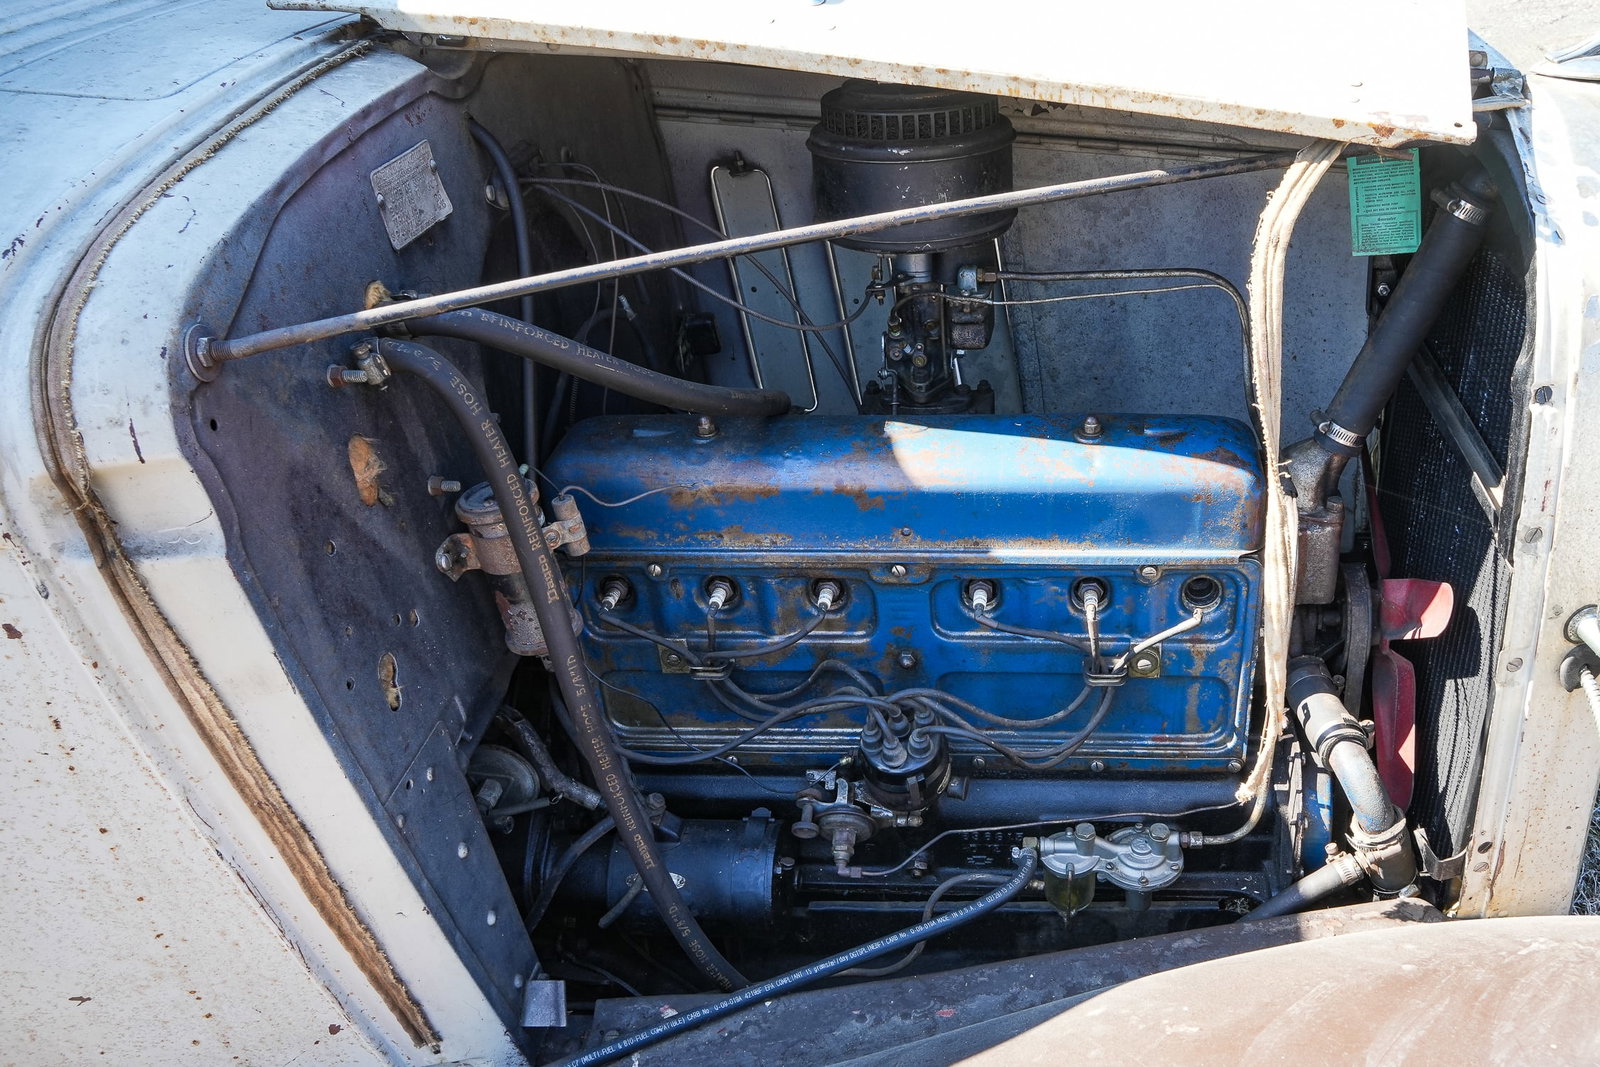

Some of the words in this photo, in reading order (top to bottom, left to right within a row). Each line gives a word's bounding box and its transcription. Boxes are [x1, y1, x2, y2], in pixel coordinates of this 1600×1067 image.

[576, 344, 620, 366] HEATER
[481, 418, 510, 468] HEATER
[507, 475, 541, 551] REINFORCED
[590, 735, 611, 770] HEATER
[604, 773, 635, 830] REINFORCED
[688, 938, 708, 963] HOSE
[581, 1047, 616, 1065] (MULTI-FUEL
[622, 1032, 649, 1047] BIO-FUEL
[650, 1018, 686, 1035] COMPATIBLE)
[686, 1010, 701, 1021] CARB
[702, 1006, 712, 1016] No.
[764, 982, 776, 992] EPA
[776, 972, 802, 987] COMPLIANT
[886, 935, 898, 944] CARB
[937, 916, 950, 924] MADE
[960, 905, 976, 916] U.S.A.
[705, 963, 731, 990] HEATER
